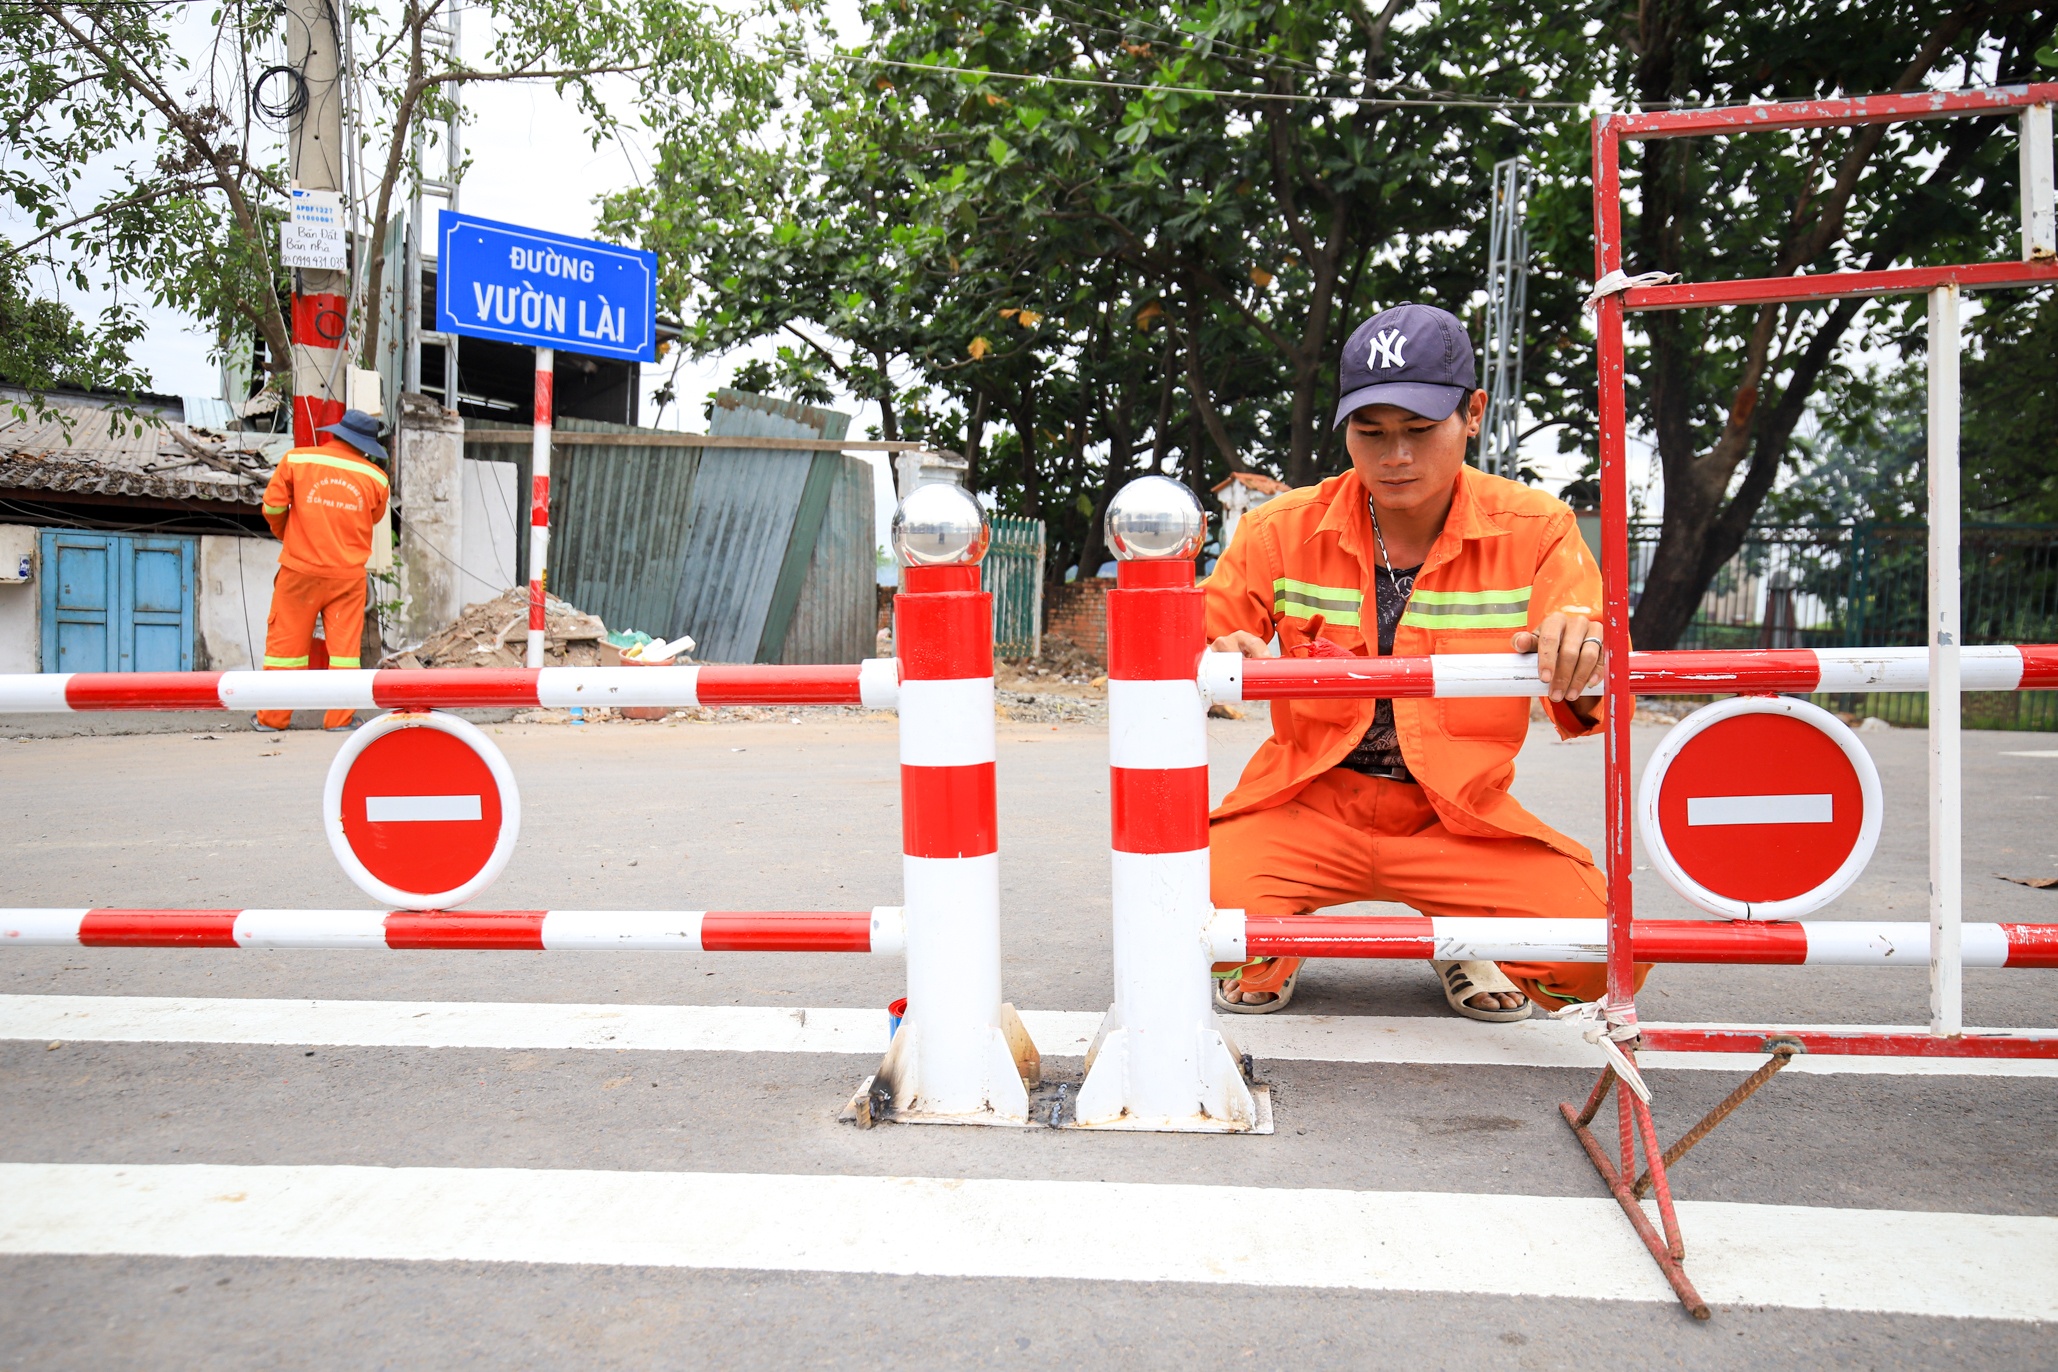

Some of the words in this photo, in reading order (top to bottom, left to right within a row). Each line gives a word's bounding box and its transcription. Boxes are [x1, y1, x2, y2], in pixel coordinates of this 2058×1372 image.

[286, 237, 306, 251] Bán
[310, 239, 330, 253] nhà
[297, 226, 318, 239] Bán
[509, 246, 595, 283] ĐƯỜNG
[473, 280, 566, 334] VƯỜN
[578, 294, 626, 344] LÀI
